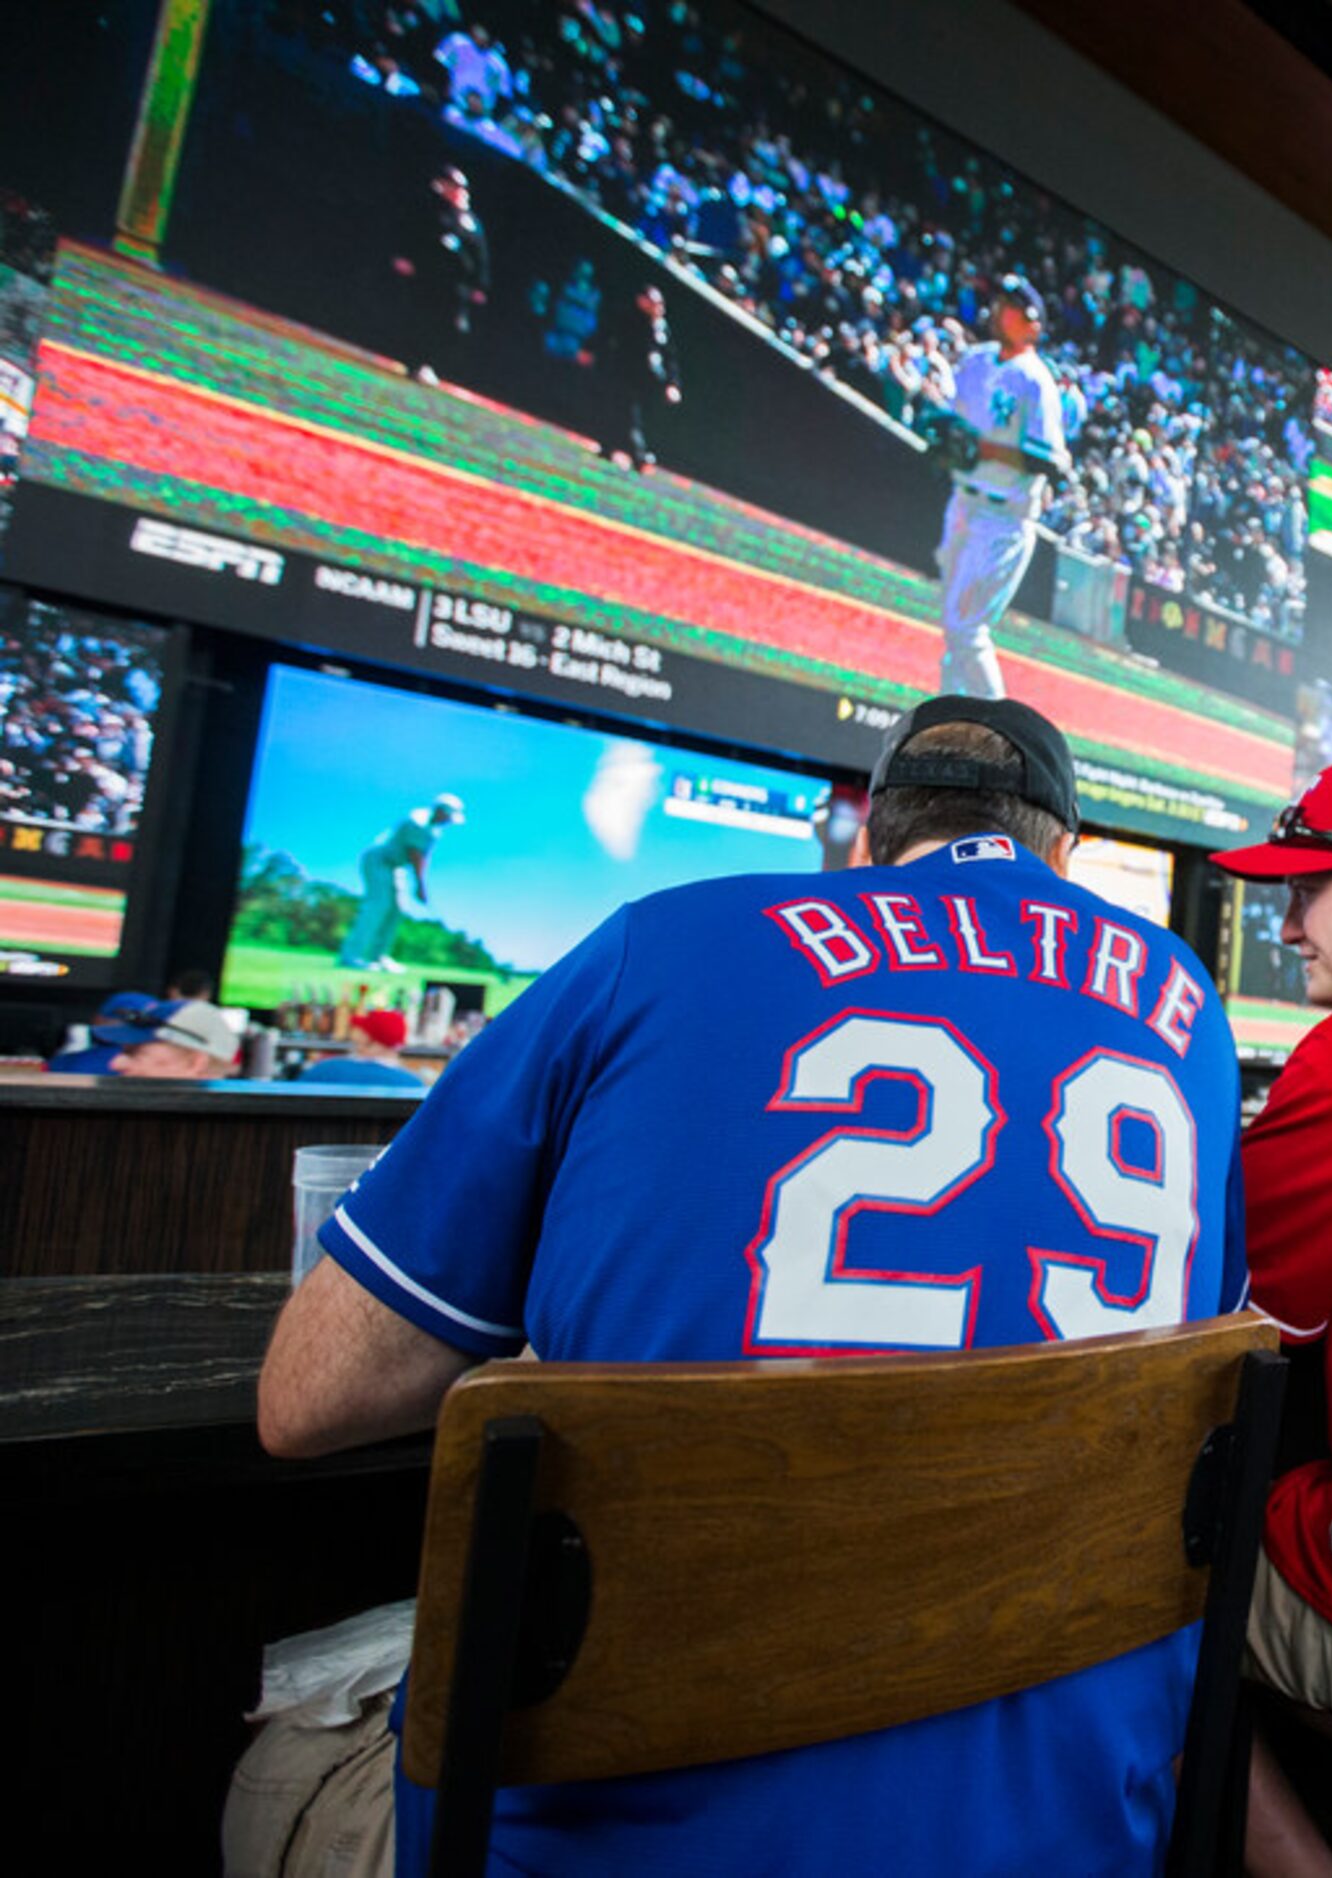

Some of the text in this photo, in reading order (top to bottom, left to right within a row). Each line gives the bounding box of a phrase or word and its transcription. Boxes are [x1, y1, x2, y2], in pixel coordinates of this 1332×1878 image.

[129, 517, 285, 585] ESPN
[454, 597, 512, 634] LSU
[762, 893, 1205, 1059] BELTRE
[743, 1007, 1199, 1357] 29
